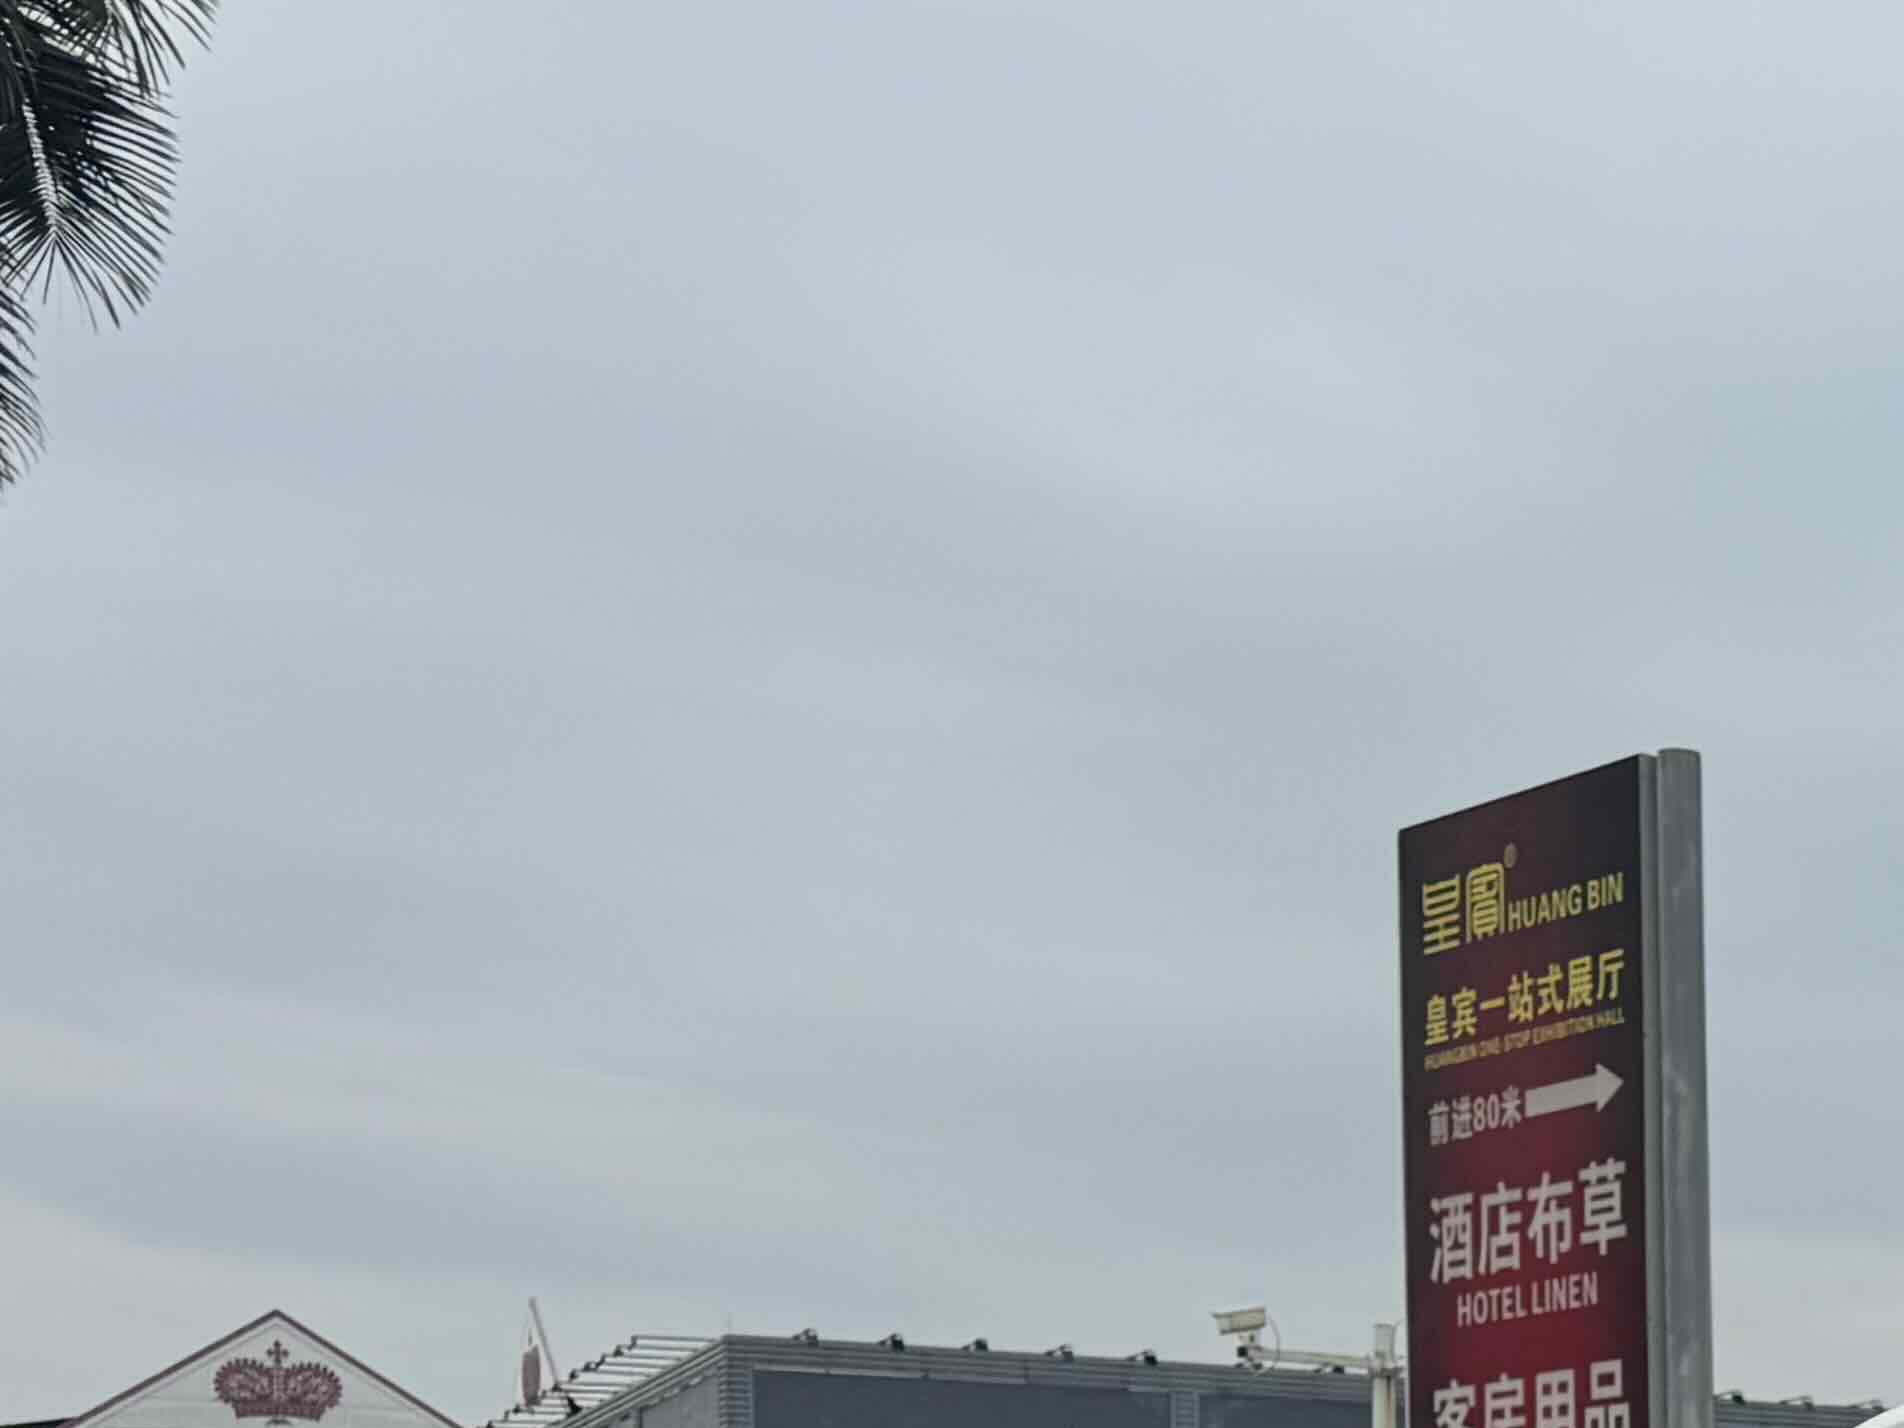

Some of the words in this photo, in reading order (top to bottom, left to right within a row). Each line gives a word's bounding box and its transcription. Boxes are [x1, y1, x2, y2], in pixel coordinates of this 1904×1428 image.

[1508, 885, 1582, 932] HUANG
[1586, 872, 1624, 911] BIN
[1424, 948, 1625, 1046] 皇宾一站式展厅
[1429, 1158, 1628, 1285] 酒店布草
[1457, 1282, 1529, 1328] HOTEL
[1531, 1271, 1599, 1316] LINEN
